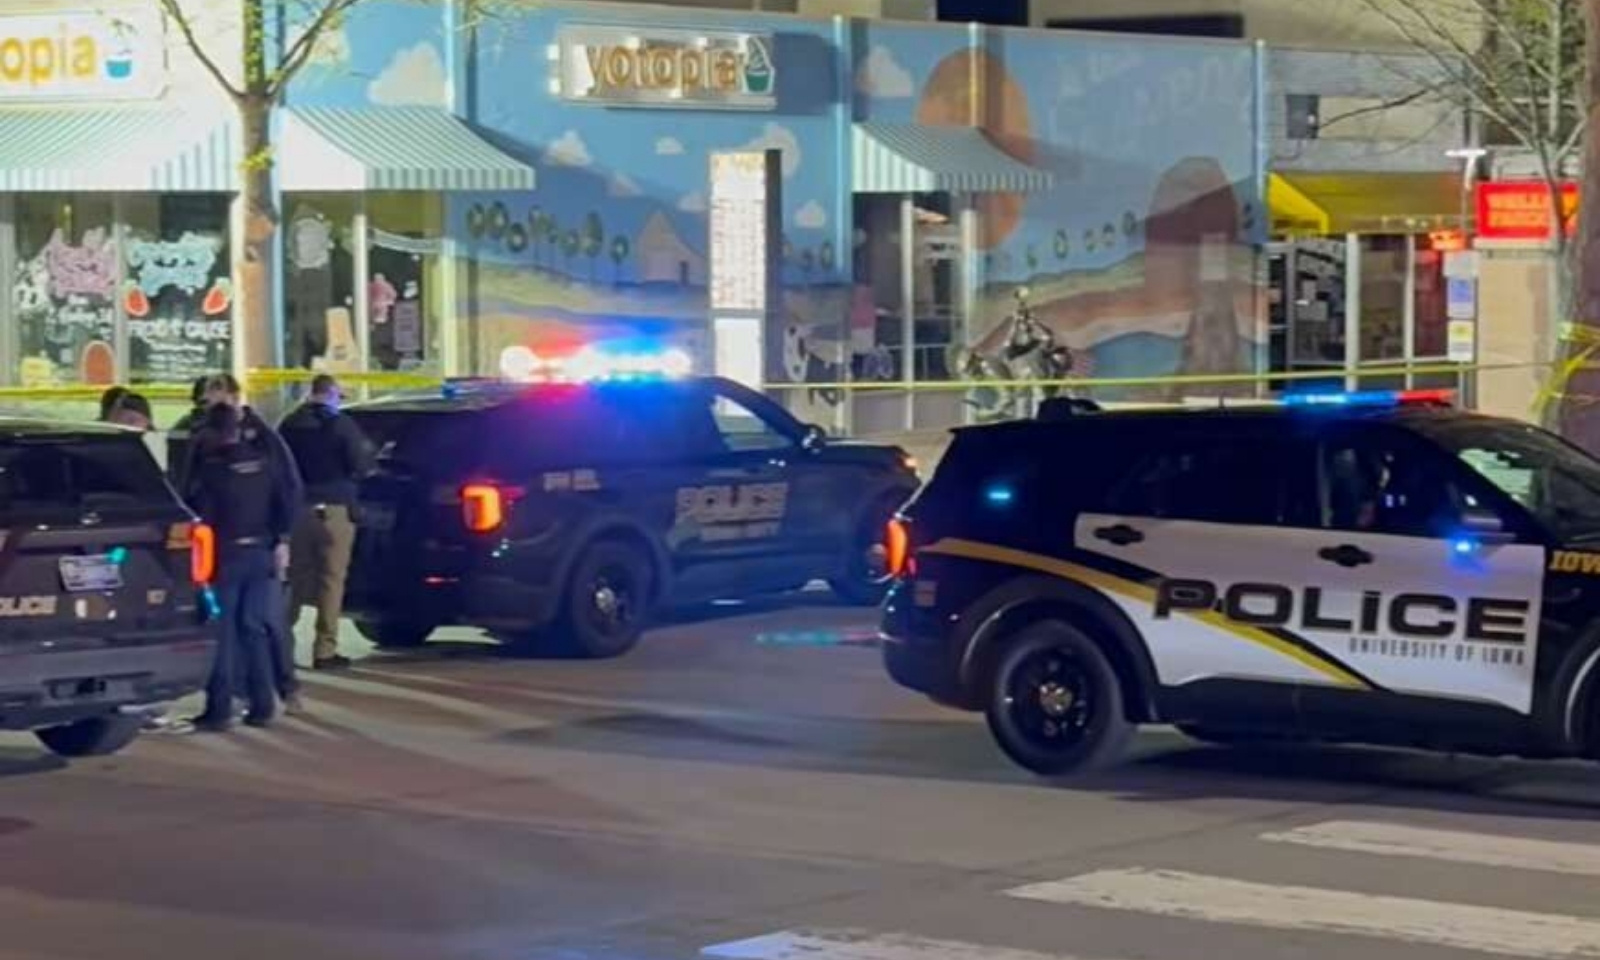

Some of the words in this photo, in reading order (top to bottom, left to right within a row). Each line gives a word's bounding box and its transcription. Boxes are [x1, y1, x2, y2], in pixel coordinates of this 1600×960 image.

[583, 43, 737, 96] yotopia
[1350, 637, 1447, 659] UNIVERSITY
[1454, 644, 1474, 662] OF
[1482, 647, 1524, 665] IOWA
